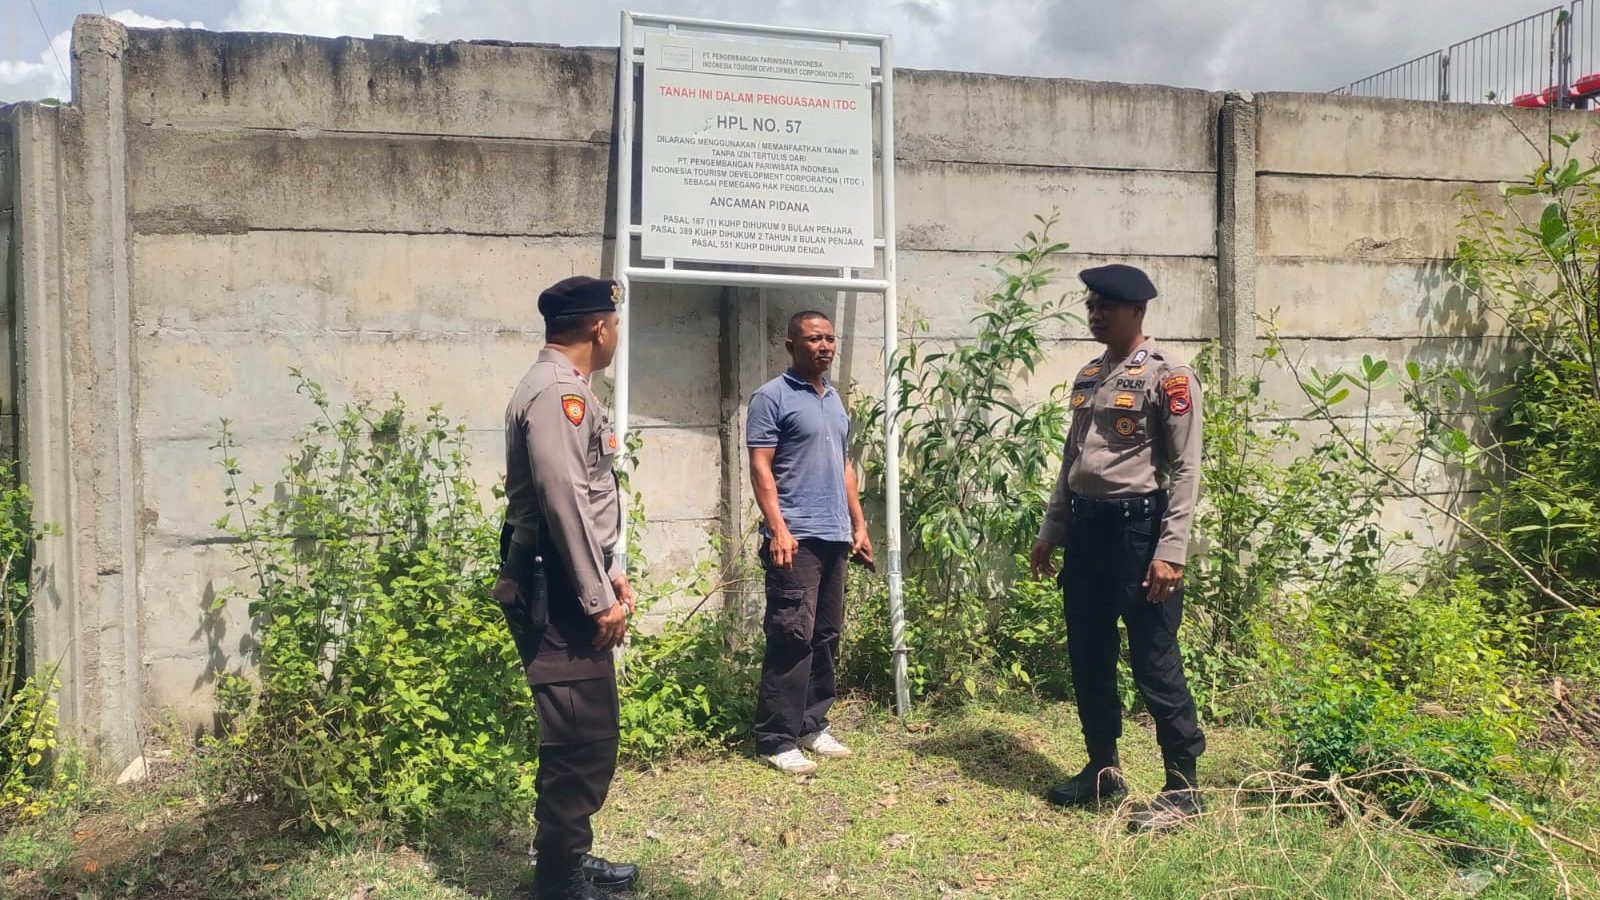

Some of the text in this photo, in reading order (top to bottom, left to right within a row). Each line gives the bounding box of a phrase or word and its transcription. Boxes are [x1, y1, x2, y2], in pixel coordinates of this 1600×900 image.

[703, 61, 732, 70] INDONESIA
[660, 86, 856, 111] TANAH INI DALAM PENGUASAAN ITDC
[717, 115, 802, 134] HPL NO. 57
[657, 134, 696, 145] DILARANG
[698, 137, 756, 150] MENGGUNAKAN
[762, 142, 821, 154] MEMANFAATKAN
[823, 146, 847, 156] TANAH
[849, 148, 858, 157] INI
[712, 148, 806, 163] TANPA IZIN TERTULIS DARI
[677, 156, 839, 175] PT. PENGEMBANGAN PARIWISATA INDONESIA
[651, 164, 691, 175] INDONESIA
[693, 167, 727, 178] TOURISM
[729, 170, 783, 182] DEVELOPMENT
[785, 174, 837, 186] CORPORATION
[843, 178, 860, 187] ITDC
[683, 176, 834, 195] SEBAGAI PEMEGANG HAK PENGELOLAAN
[710, 196, 809, 213] ANCAMAN PIDANA
[664, 214, 689, 225] PASAL
[692, 216, 704, 226] 167
[707, 217, 716, 227] (1)
[719, 218, 741, 228] KUHP
[743, 220, 779, 231] DIHUKUM
[788, 223, 814, 234] BULAN
[817, 225, 852, 236] PENJARA
[651, 224, 677, 234] PASAL
[680, 226, 693, 236] 389
[695, 227, 717, 237] KUHP
[719, 229, 756, 240] DIHUKUM
[764, 232, 791, 242] TAHUN
[799, 234, 826, 245] BULAN
[828, 236, 864, 247] PENJARA
[692, 238, 824, 255] PASAL 551 KUHP DIHUKUM DENDA
[1116, 378, 1146, 390] POLRI
